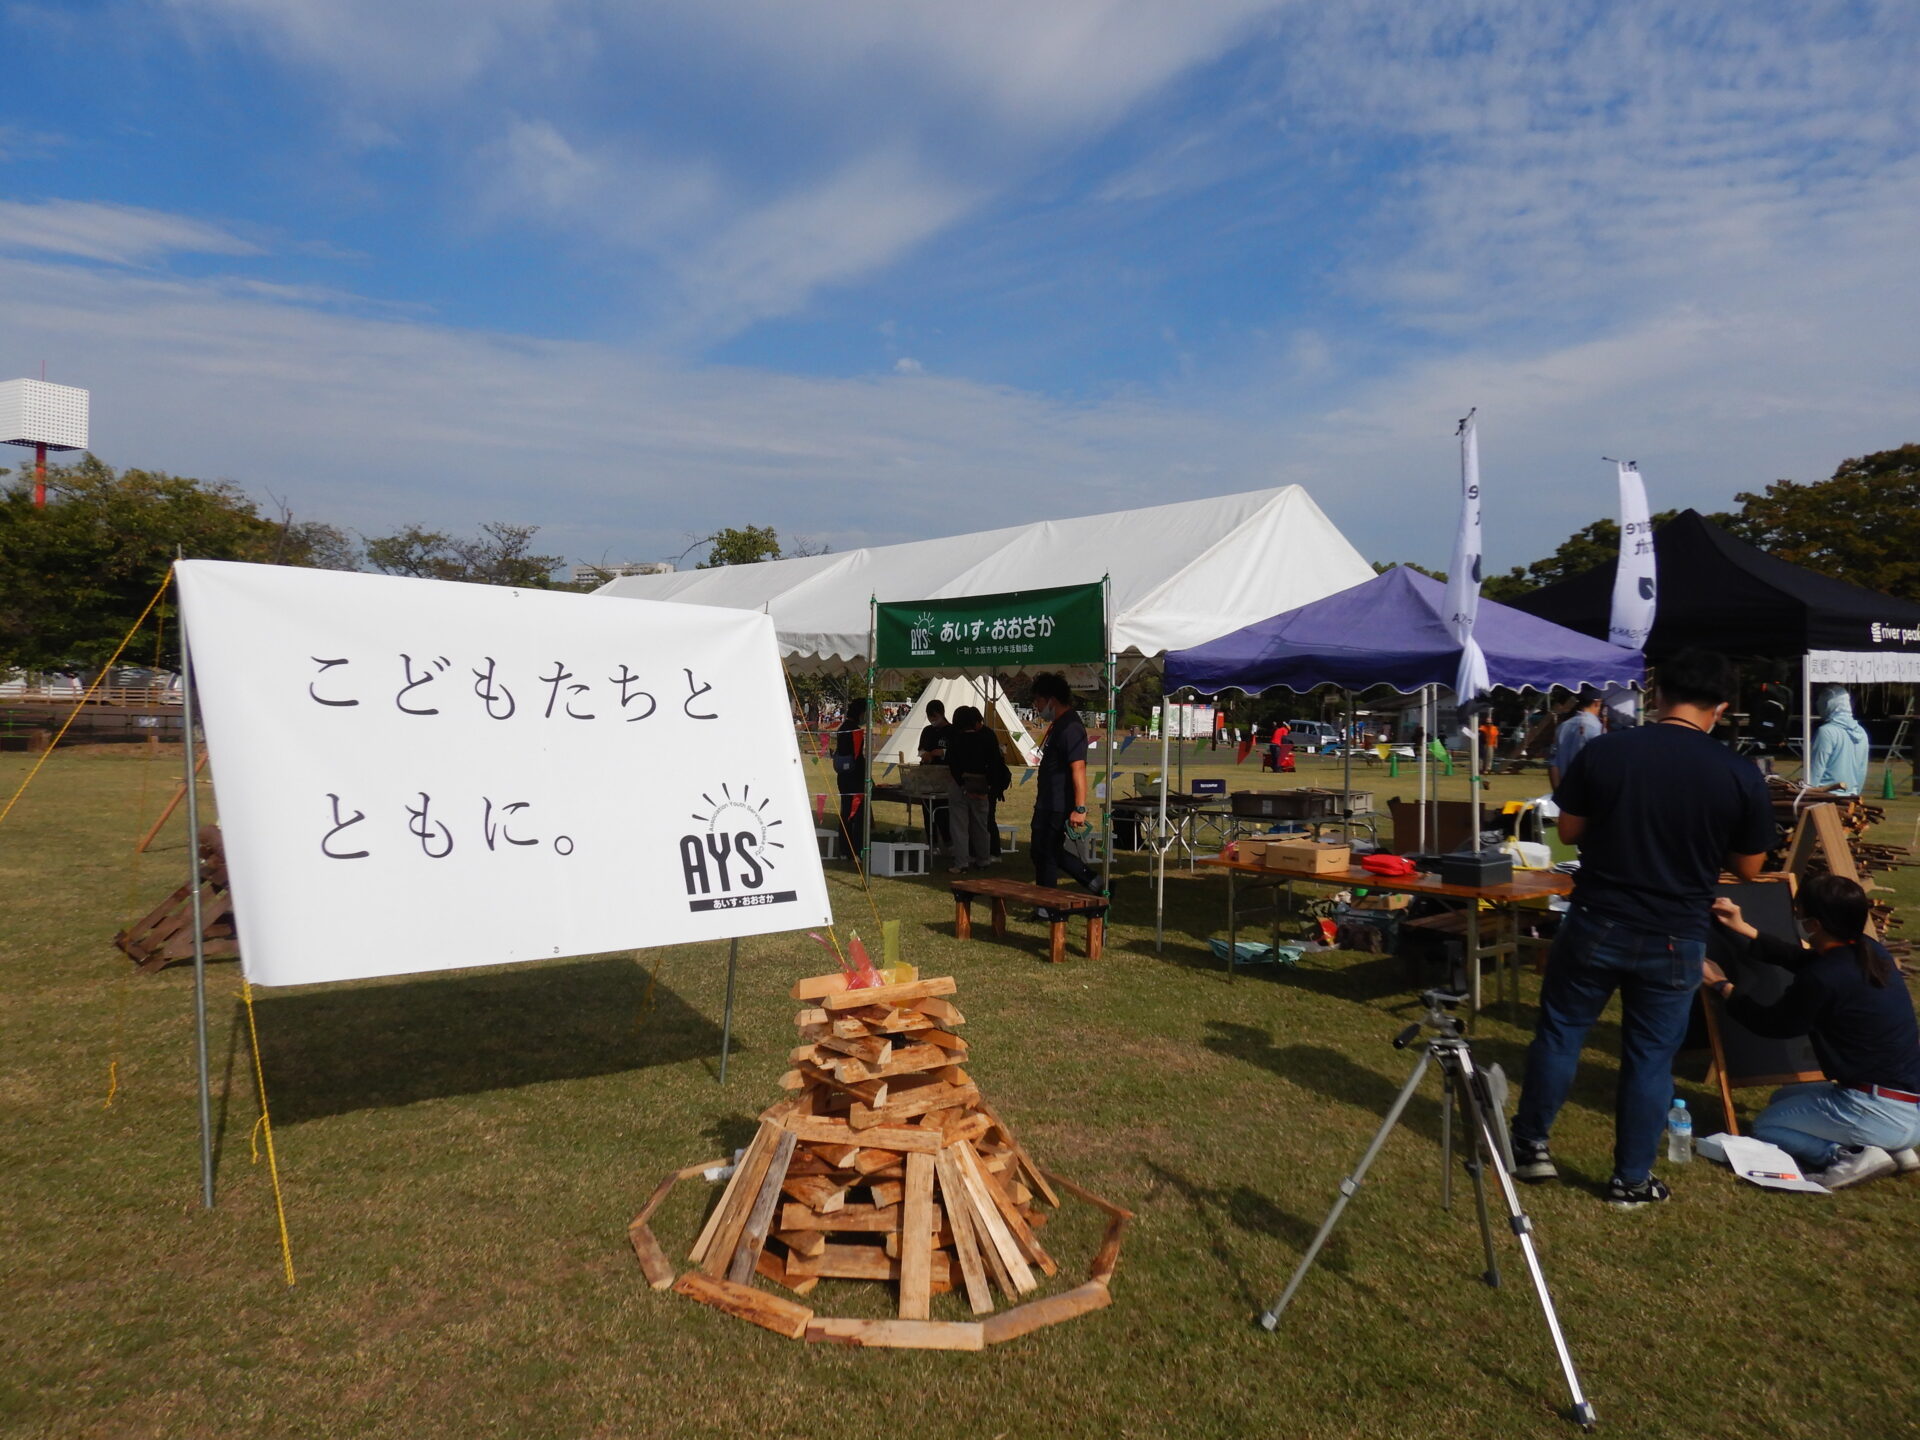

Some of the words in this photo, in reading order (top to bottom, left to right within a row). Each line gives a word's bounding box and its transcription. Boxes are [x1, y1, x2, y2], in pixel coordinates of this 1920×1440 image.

[910, 628, 929, 650] AYS
[940, 614, 1056, 643] あいす・おおさか
[1881, 622, 1901, 640] river
[309, 653, 719, 722] こどもたちと
[321, 791, 575, 860] ともに。
[680, 831, 764, 895] AYS
[713, 894, 775, 909] あいす・おおさか
